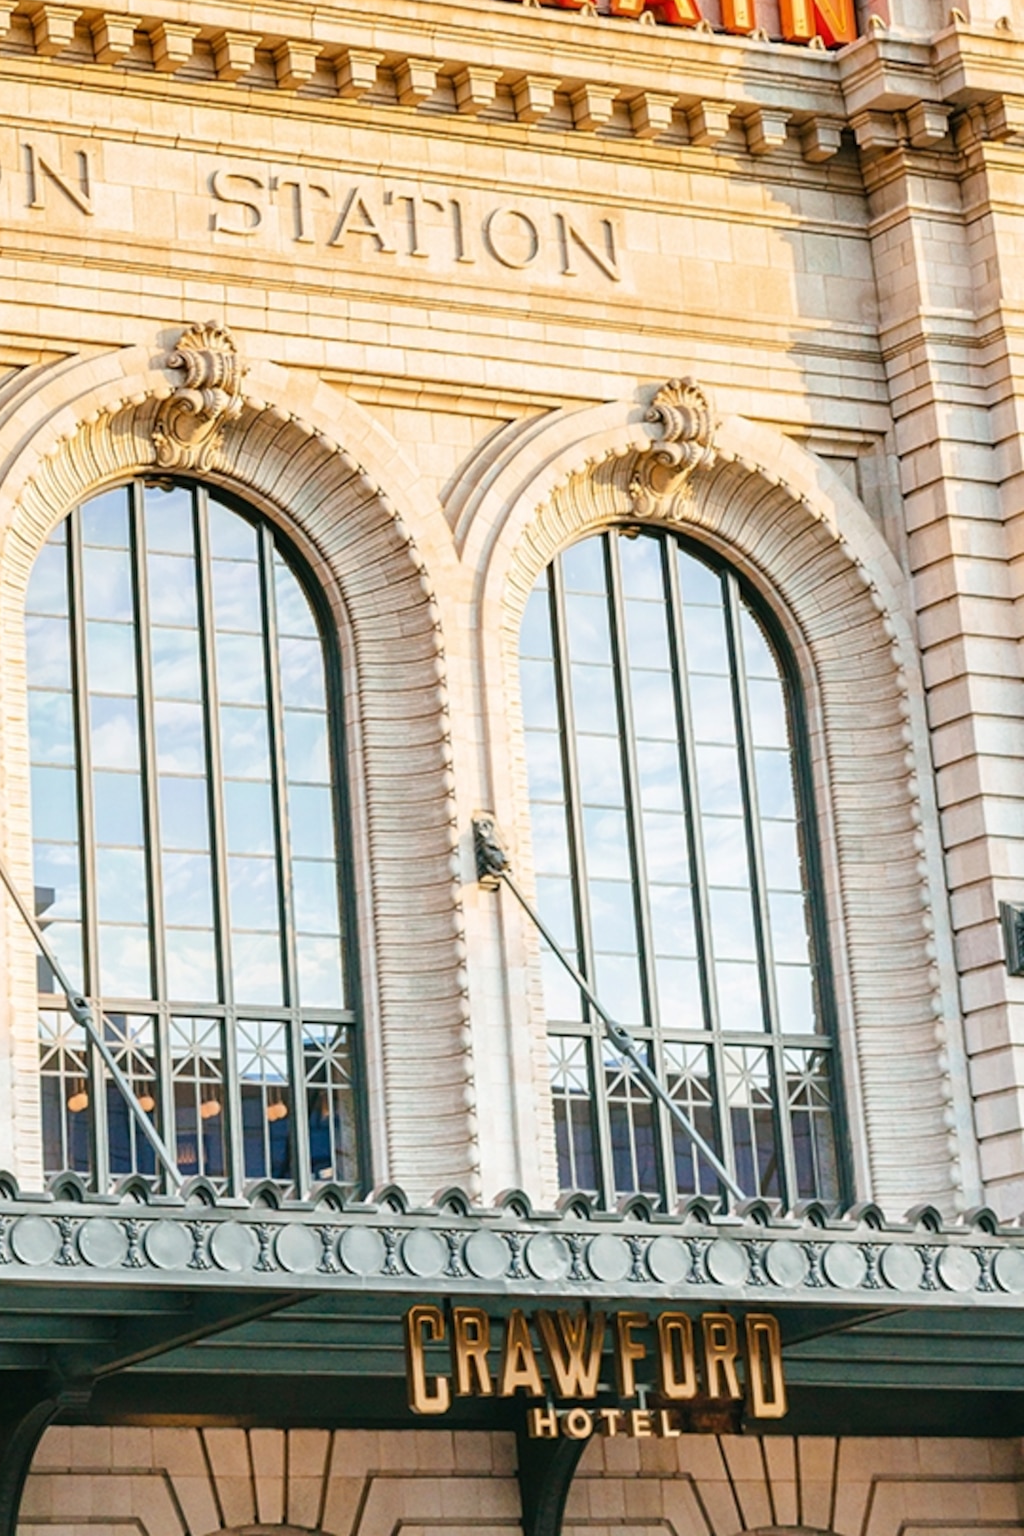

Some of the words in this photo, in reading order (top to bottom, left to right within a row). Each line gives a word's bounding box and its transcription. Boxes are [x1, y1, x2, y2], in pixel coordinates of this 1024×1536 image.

[209, 168, 620, 282] STATION
[404, 1304, 788, 1419] CRAWFORD
[528, 1408, 681, 1439] HOTEL
